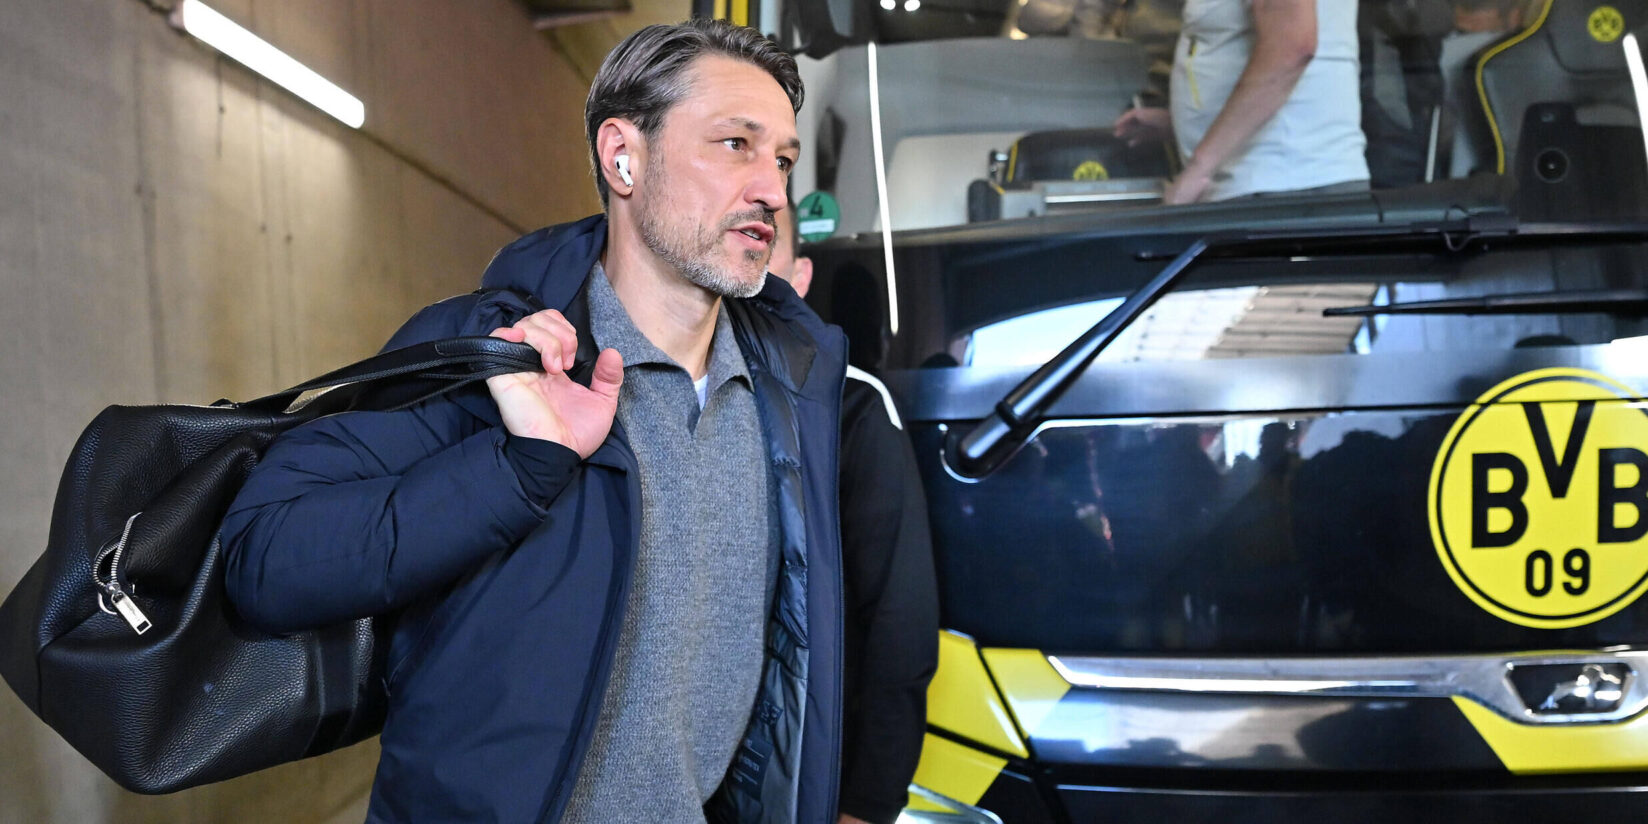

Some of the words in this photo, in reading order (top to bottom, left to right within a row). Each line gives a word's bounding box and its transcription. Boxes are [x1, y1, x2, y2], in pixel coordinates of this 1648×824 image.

[810, 195, 823, 218] 4
[1472, 401, 1648, 548] BVB
[1525, 548, 1590, 597] 09
